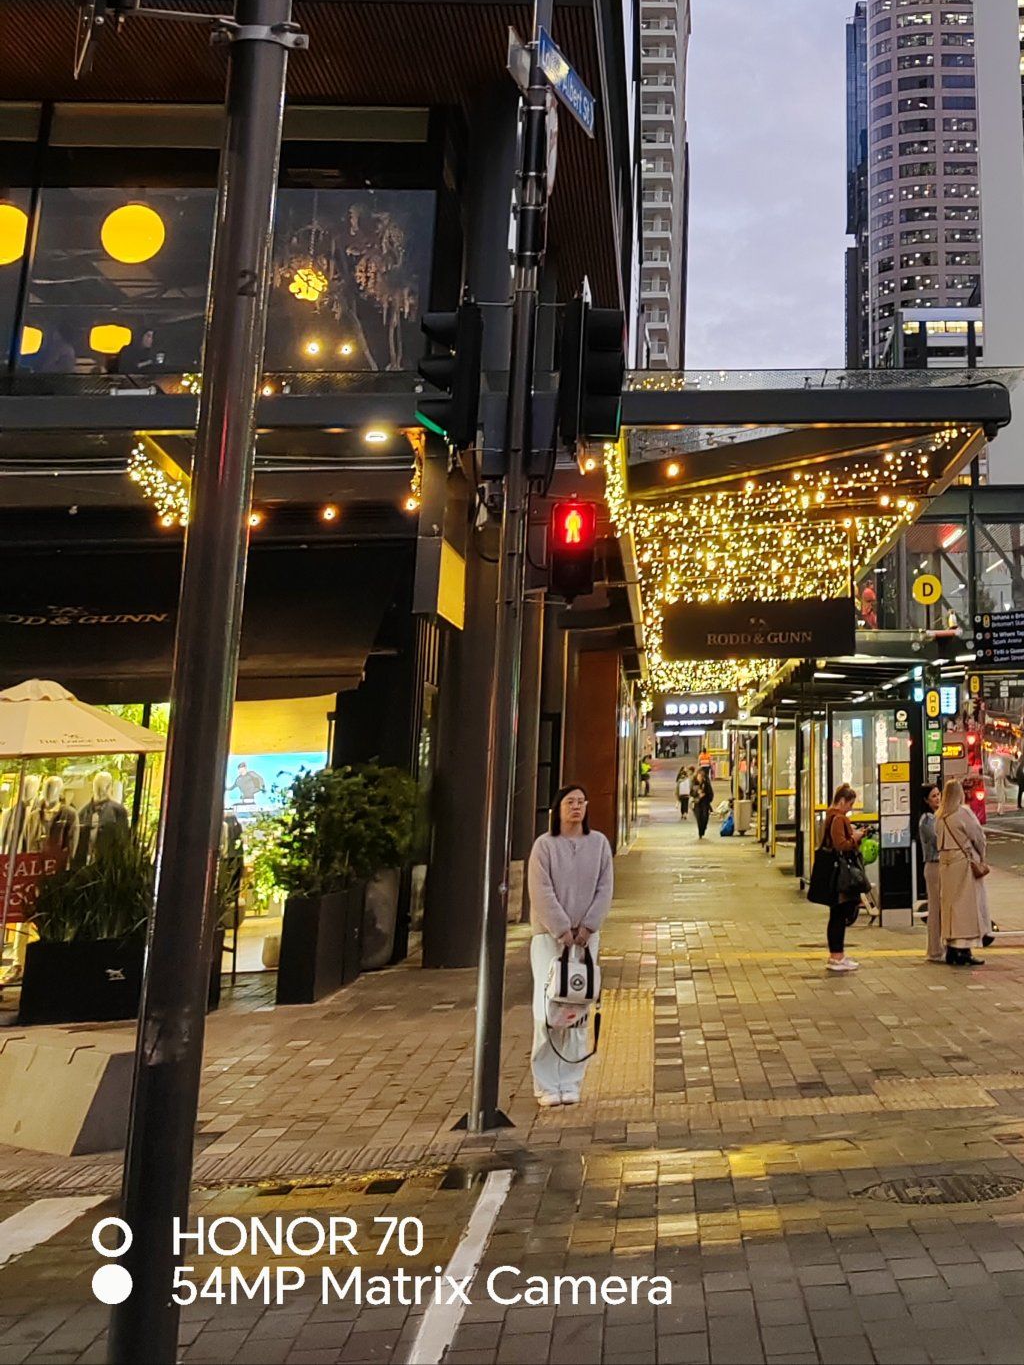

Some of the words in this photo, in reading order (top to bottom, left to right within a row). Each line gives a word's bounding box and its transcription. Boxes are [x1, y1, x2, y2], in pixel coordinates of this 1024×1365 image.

[923, 583, 934, 597] D
[78, 613, 168, 624] GUNN
[707, 633, 750, 646] RODD
[753, 634, 765, 644] &
[767, 632, 812, 643] GUNN
[4, 860, 56, 877] SALE
